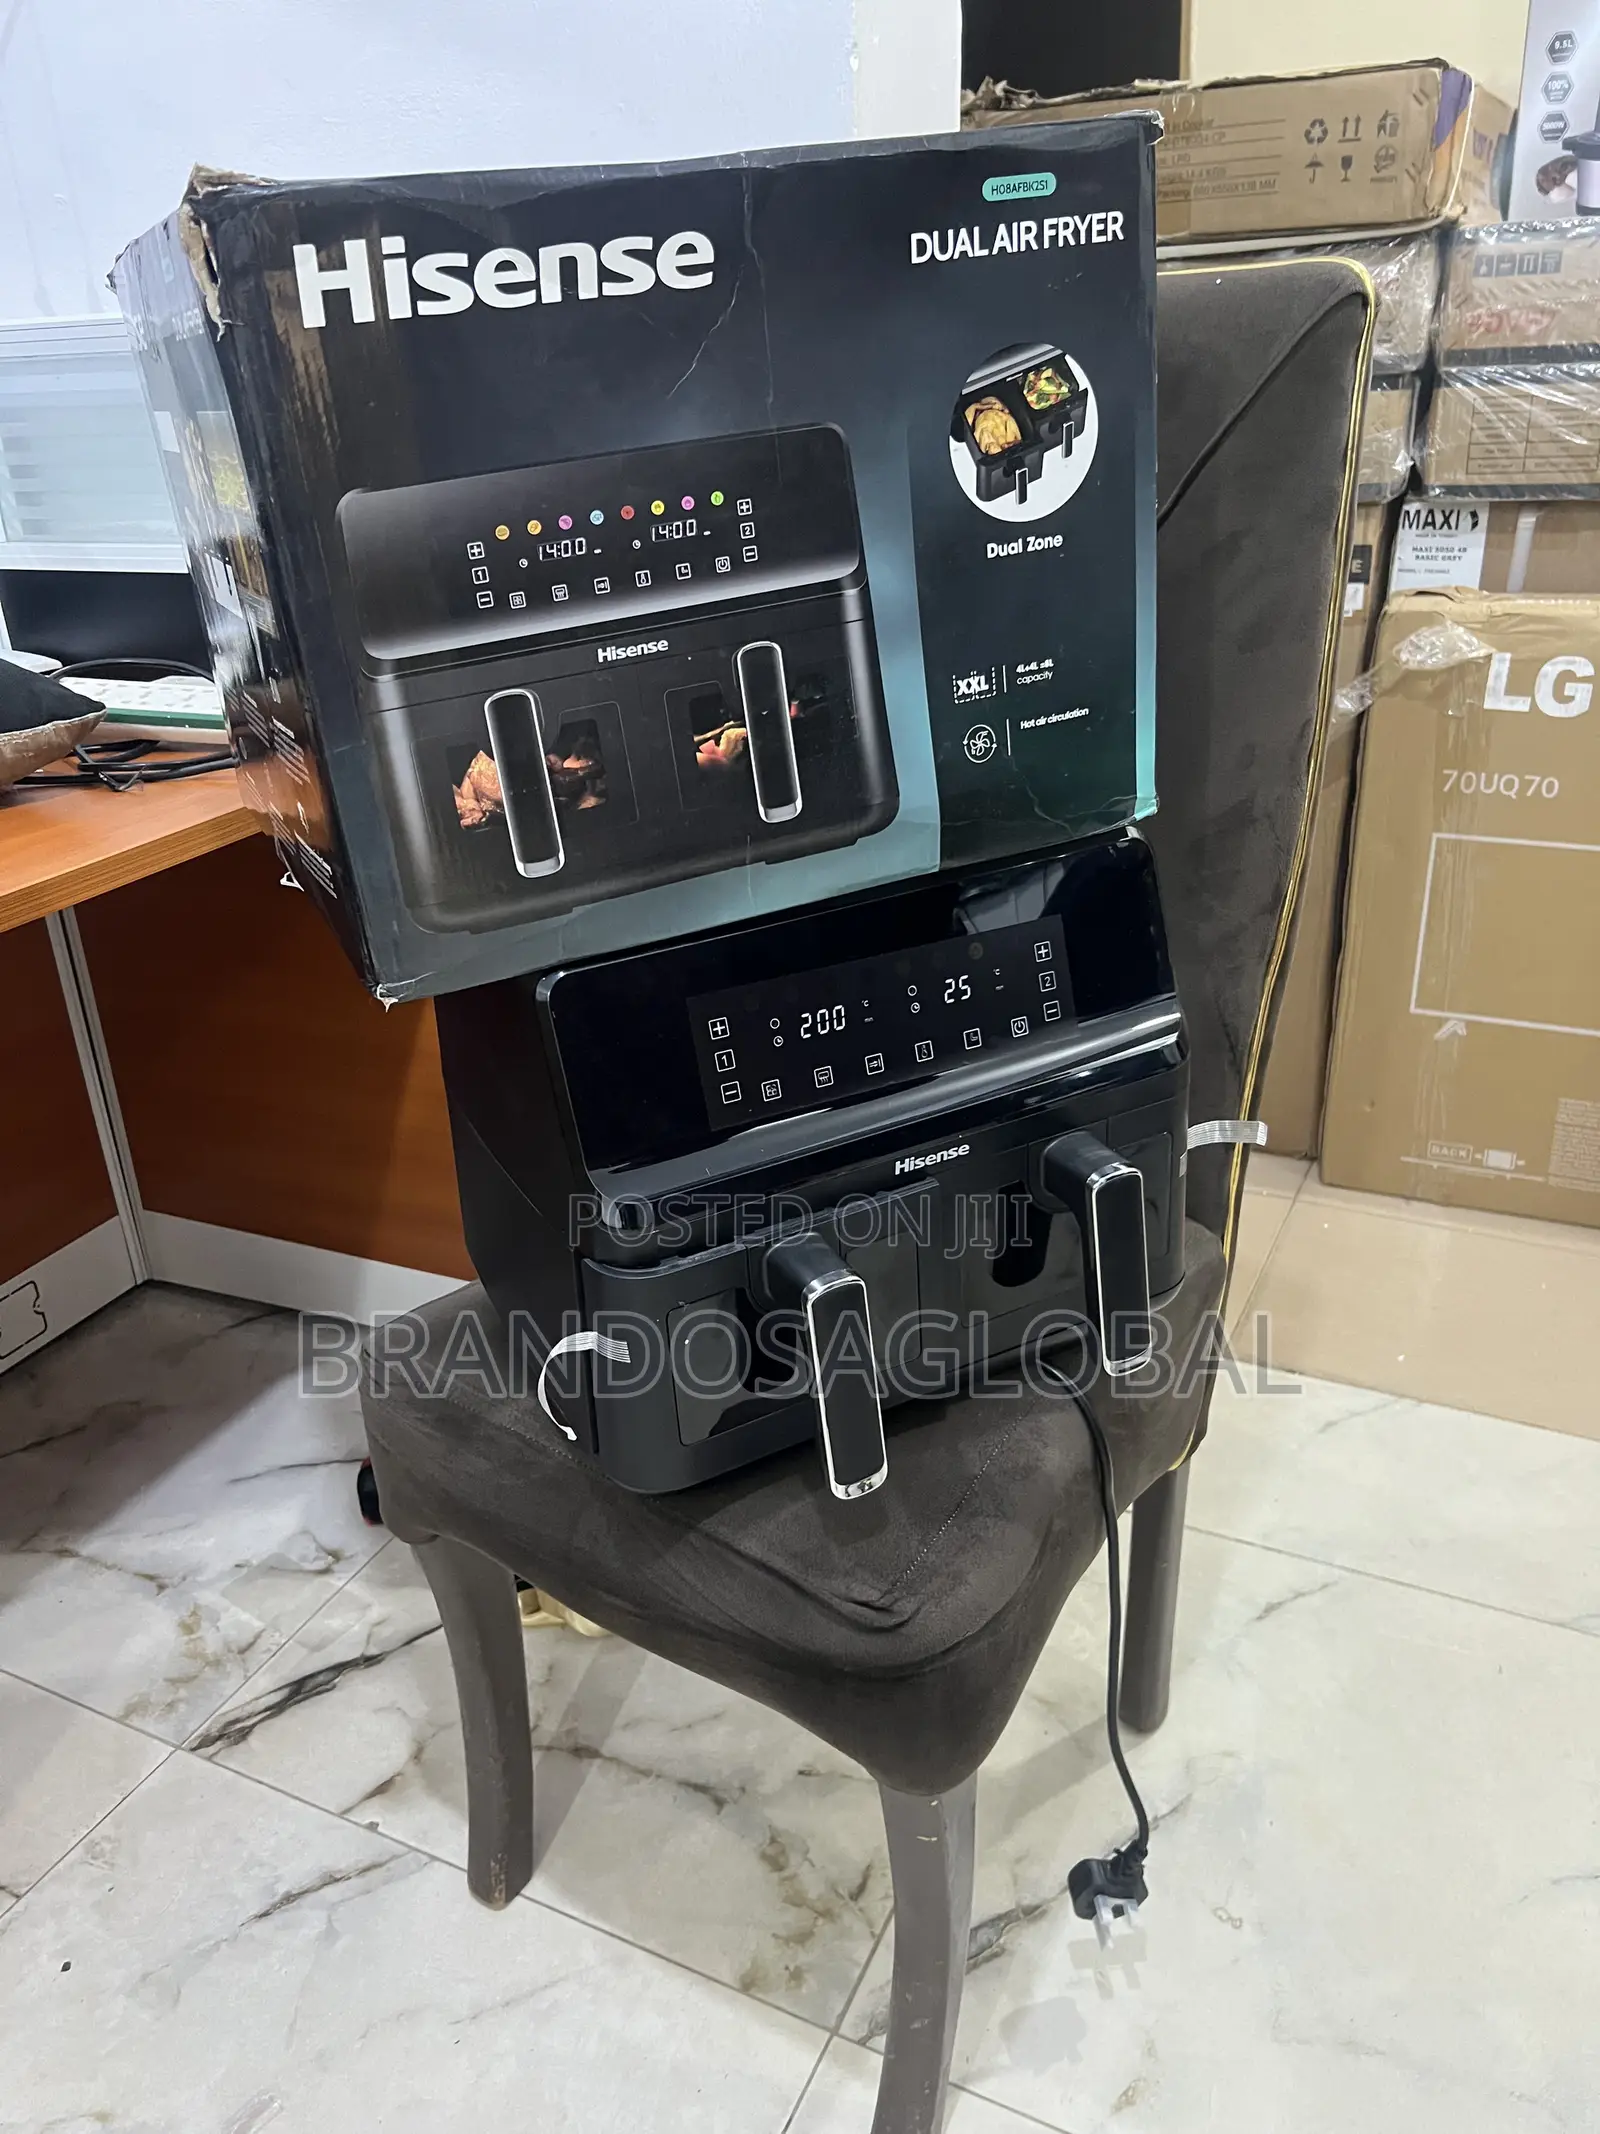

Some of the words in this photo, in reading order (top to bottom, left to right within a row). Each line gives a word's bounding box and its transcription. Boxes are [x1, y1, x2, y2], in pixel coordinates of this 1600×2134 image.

[911, 226, 989, 264] DUAL
[992, 220, 1039, 255] AIR
[1043, 210, 1125, 249] FRYER
[292, 231, 715, 329] Hisense
[651, 518, 697, 542] 14:00
[1402, 509, 1460, 530] MAXI
[539, 537, 586, 561] 14:00
[986, 538, 1023, 559] Dual
[1026, 534, 1064, 552] Zone
[596, 638, 671, 663] Hisense
[956, 675, 990, 696] XXL
[1016, 670, 1053, 685] capacity
[1483, 652, 1595, 718] LG
[1020, 719, 1036, 730] Hot
[1036, 715, 1048, 726] air
[1047, 708, 1090, 723] circulation
[944, 975, 971, 1004] 25
[800, 1004, 845, 1039] 200
[894, 1143, 971, 1176] Hisense
